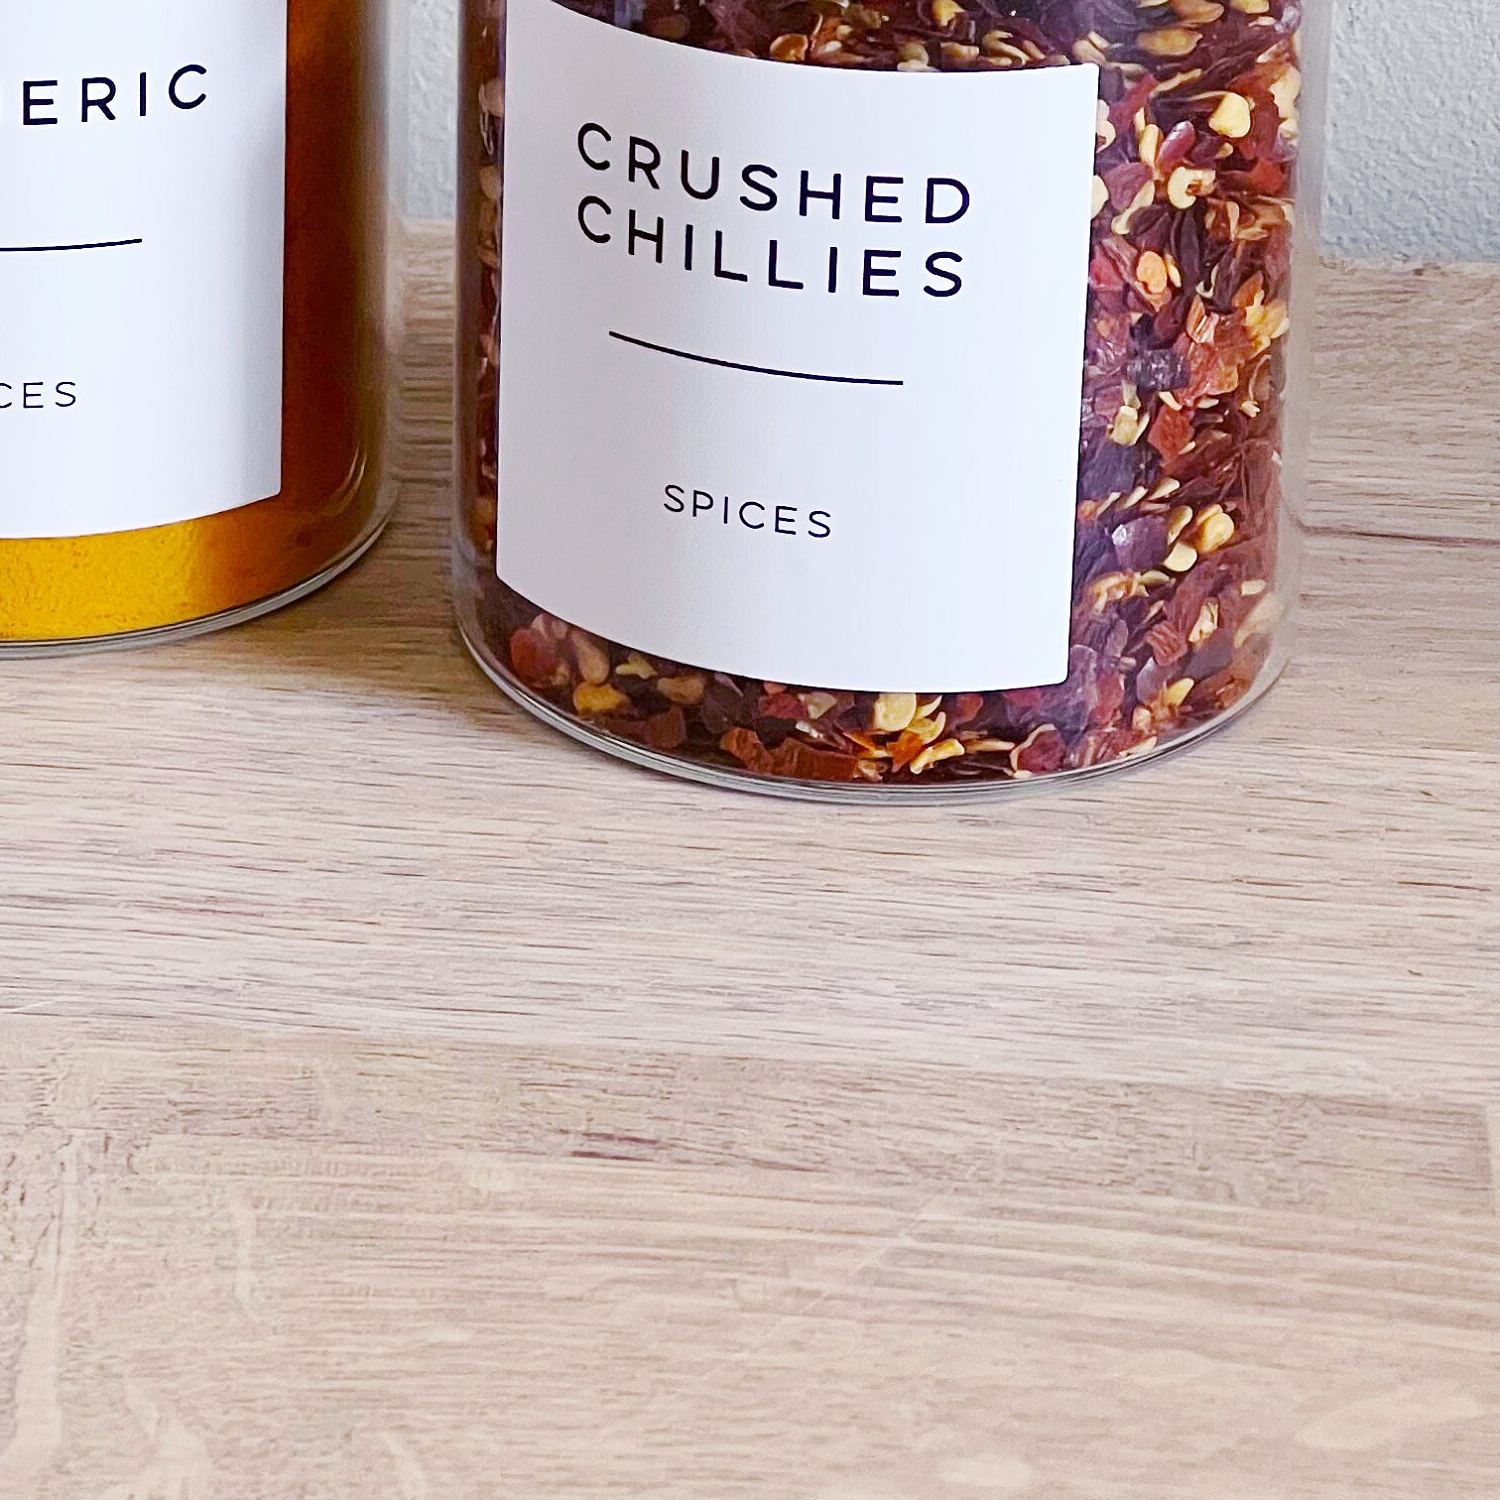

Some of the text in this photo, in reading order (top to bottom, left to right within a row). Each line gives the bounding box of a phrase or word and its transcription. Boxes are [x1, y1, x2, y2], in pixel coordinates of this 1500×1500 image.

[577, 122, 970, 224] CRUSHED
[577, 195, 963, 298] CHILLIES
[663, 484, 831, 539] SPICES
